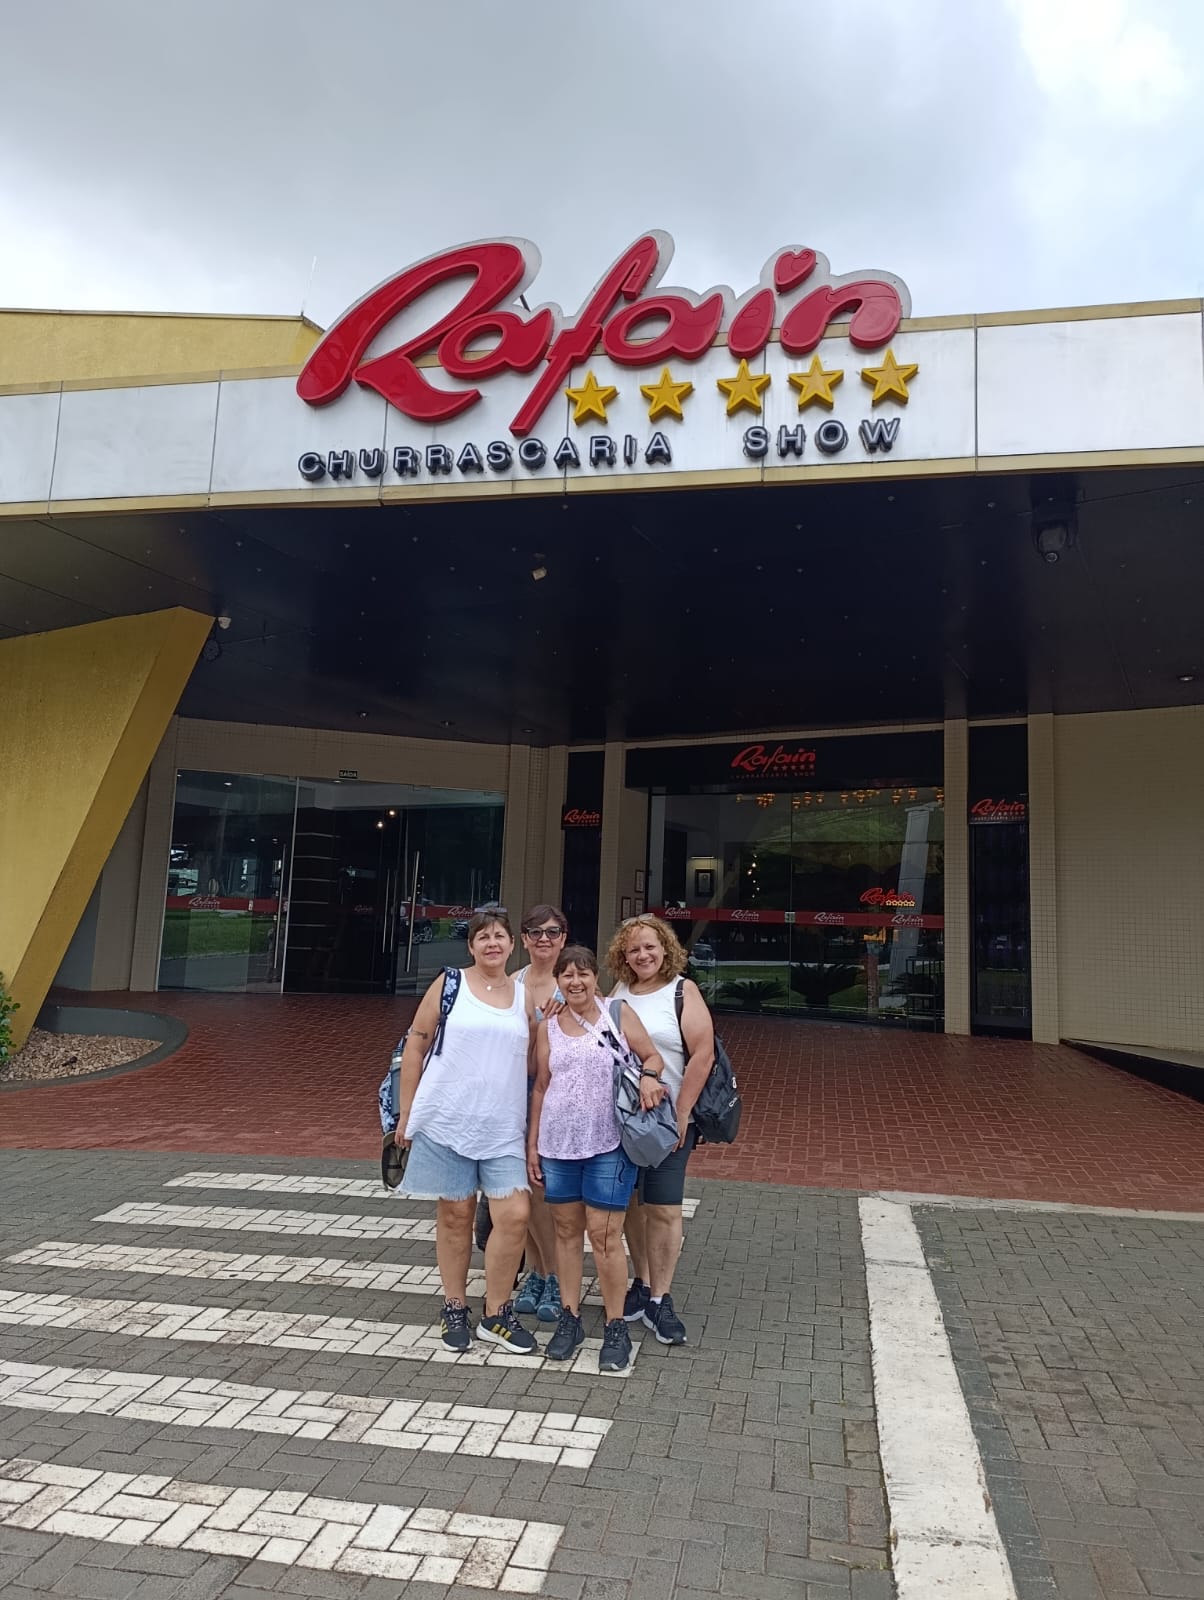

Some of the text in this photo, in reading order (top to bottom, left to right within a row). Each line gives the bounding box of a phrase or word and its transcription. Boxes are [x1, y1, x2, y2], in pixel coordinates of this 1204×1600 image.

[296, 235, 902, 436] Rafain
[298, 417, 901, 482] CHURRASCARIA SHOW
[730, 744, 816, 773] Rafain
[564, 809, 600, 824] Rafain
[971, 798, 1025, 816] Rafain
[859, 887, 916, 905] Rafain
